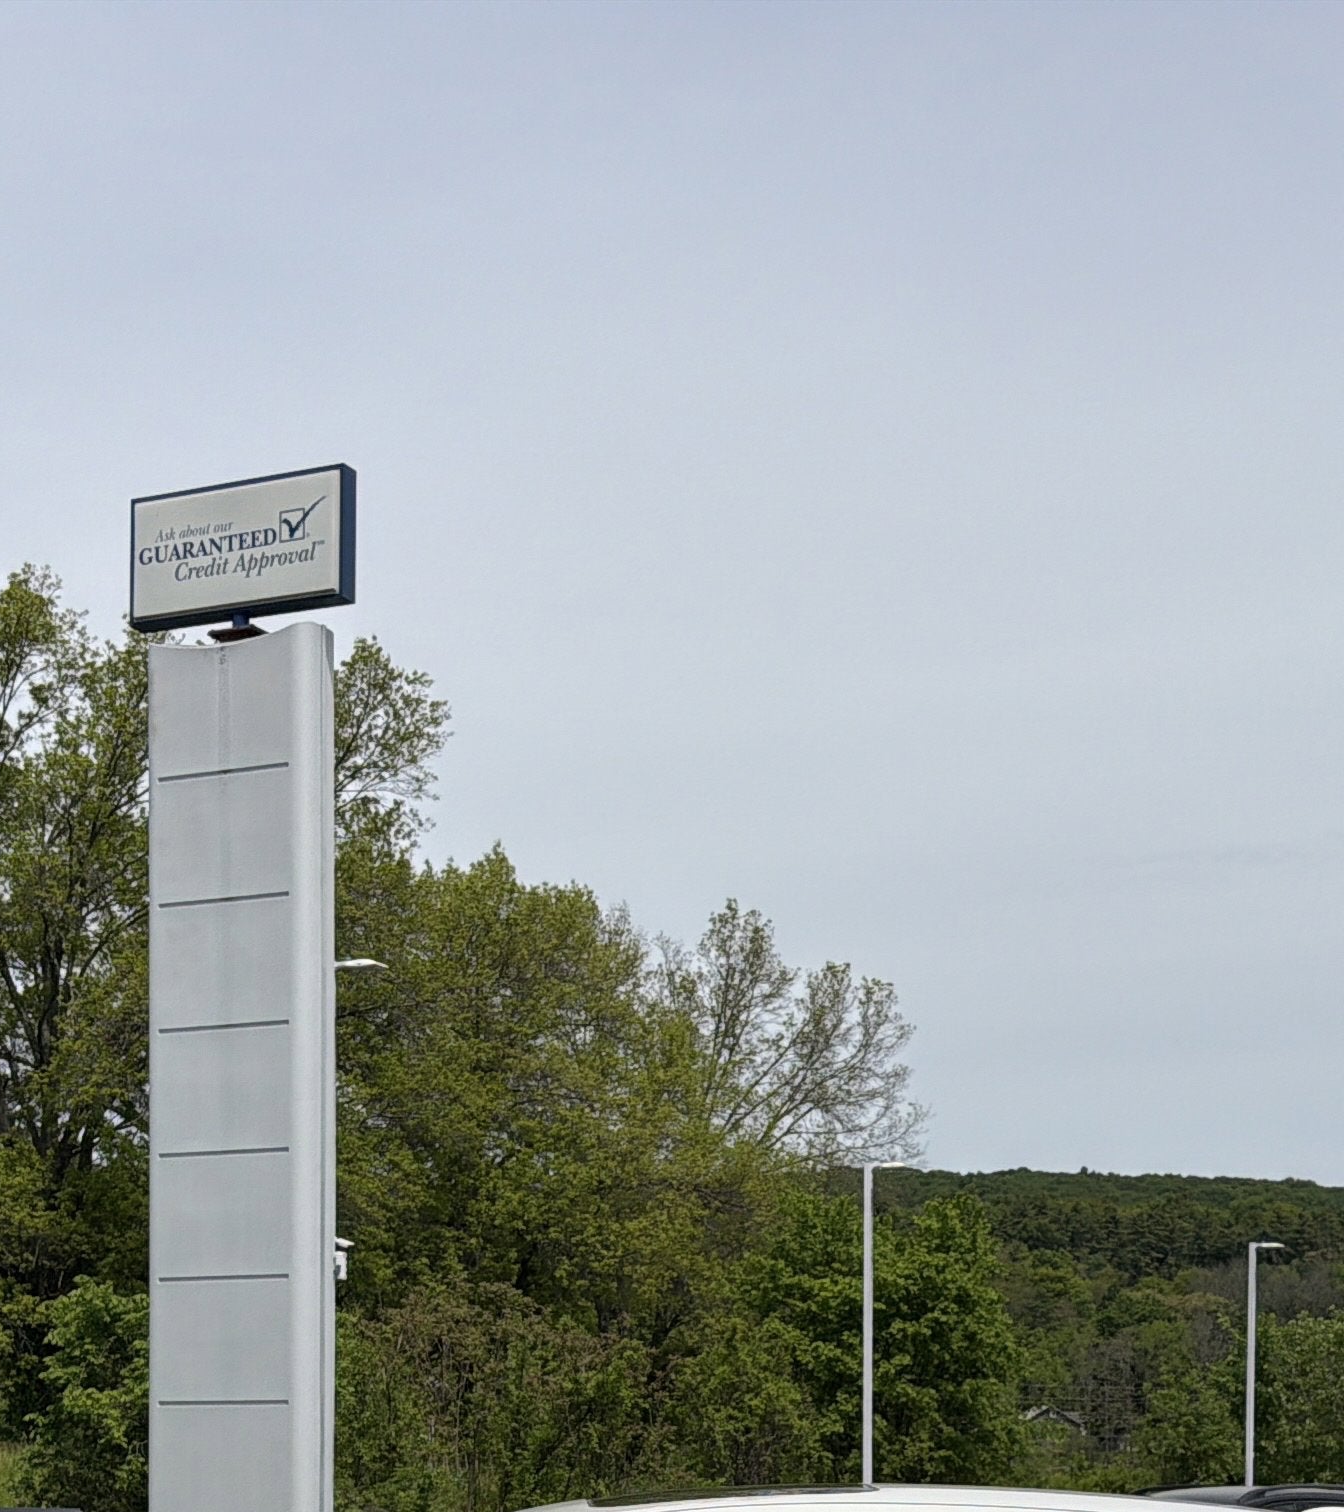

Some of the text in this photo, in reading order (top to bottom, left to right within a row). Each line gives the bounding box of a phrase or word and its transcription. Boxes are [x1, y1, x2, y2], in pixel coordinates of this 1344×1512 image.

[154, 521, 234, 543] Ask about our
[138, 527, 277, 566] GUARANTEED
[174, 555, 229, 582] Credit
